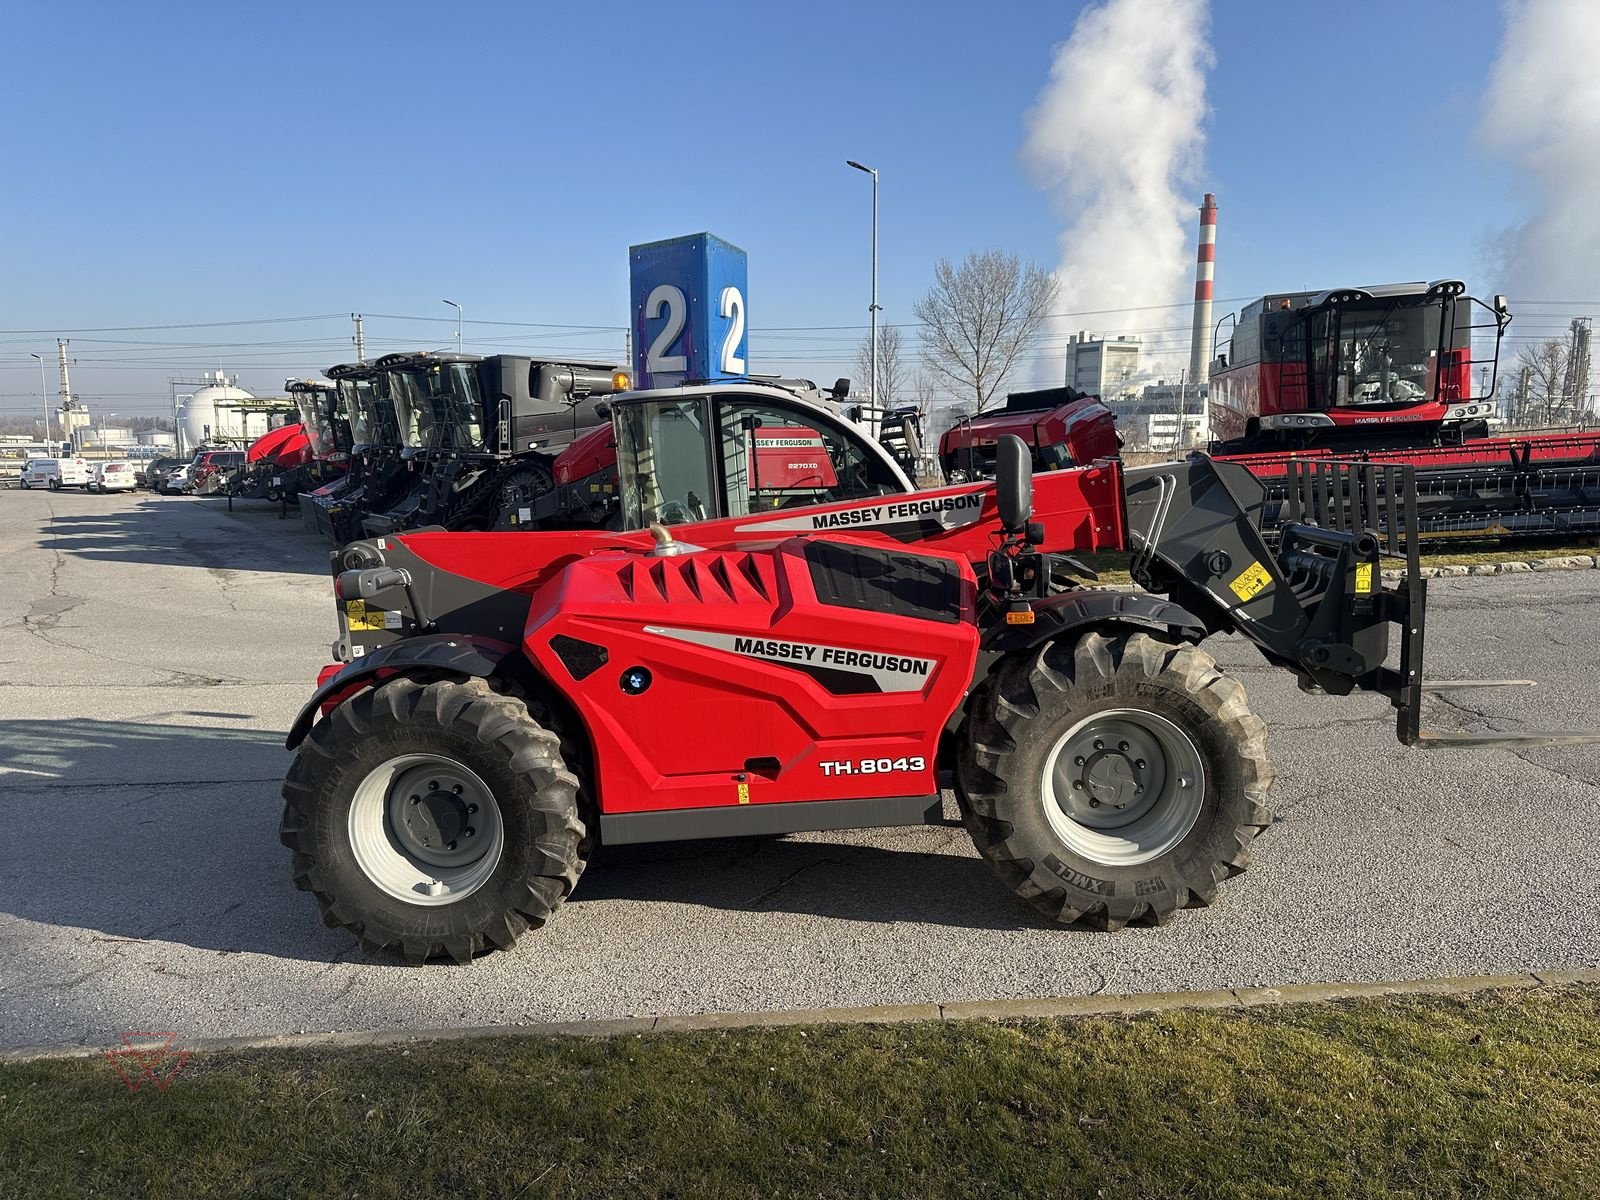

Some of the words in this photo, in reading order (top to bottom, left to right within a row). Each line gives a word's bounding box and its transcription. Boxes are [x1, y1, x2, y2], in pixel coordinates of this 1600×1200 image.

[645, 284, 687, 373] 2
[720, 286, 745, 374] 2
[812, 507, 882, 529] MASSEY
[887, 494, 980, 518] FERGUSON
[734, 638, 816, 660] MASSEY
[822, 649, 928, 675] FERGUSON
[819, 757, 925, 775] TH.8043
[1056, 862, 1103, 892] XMCL
